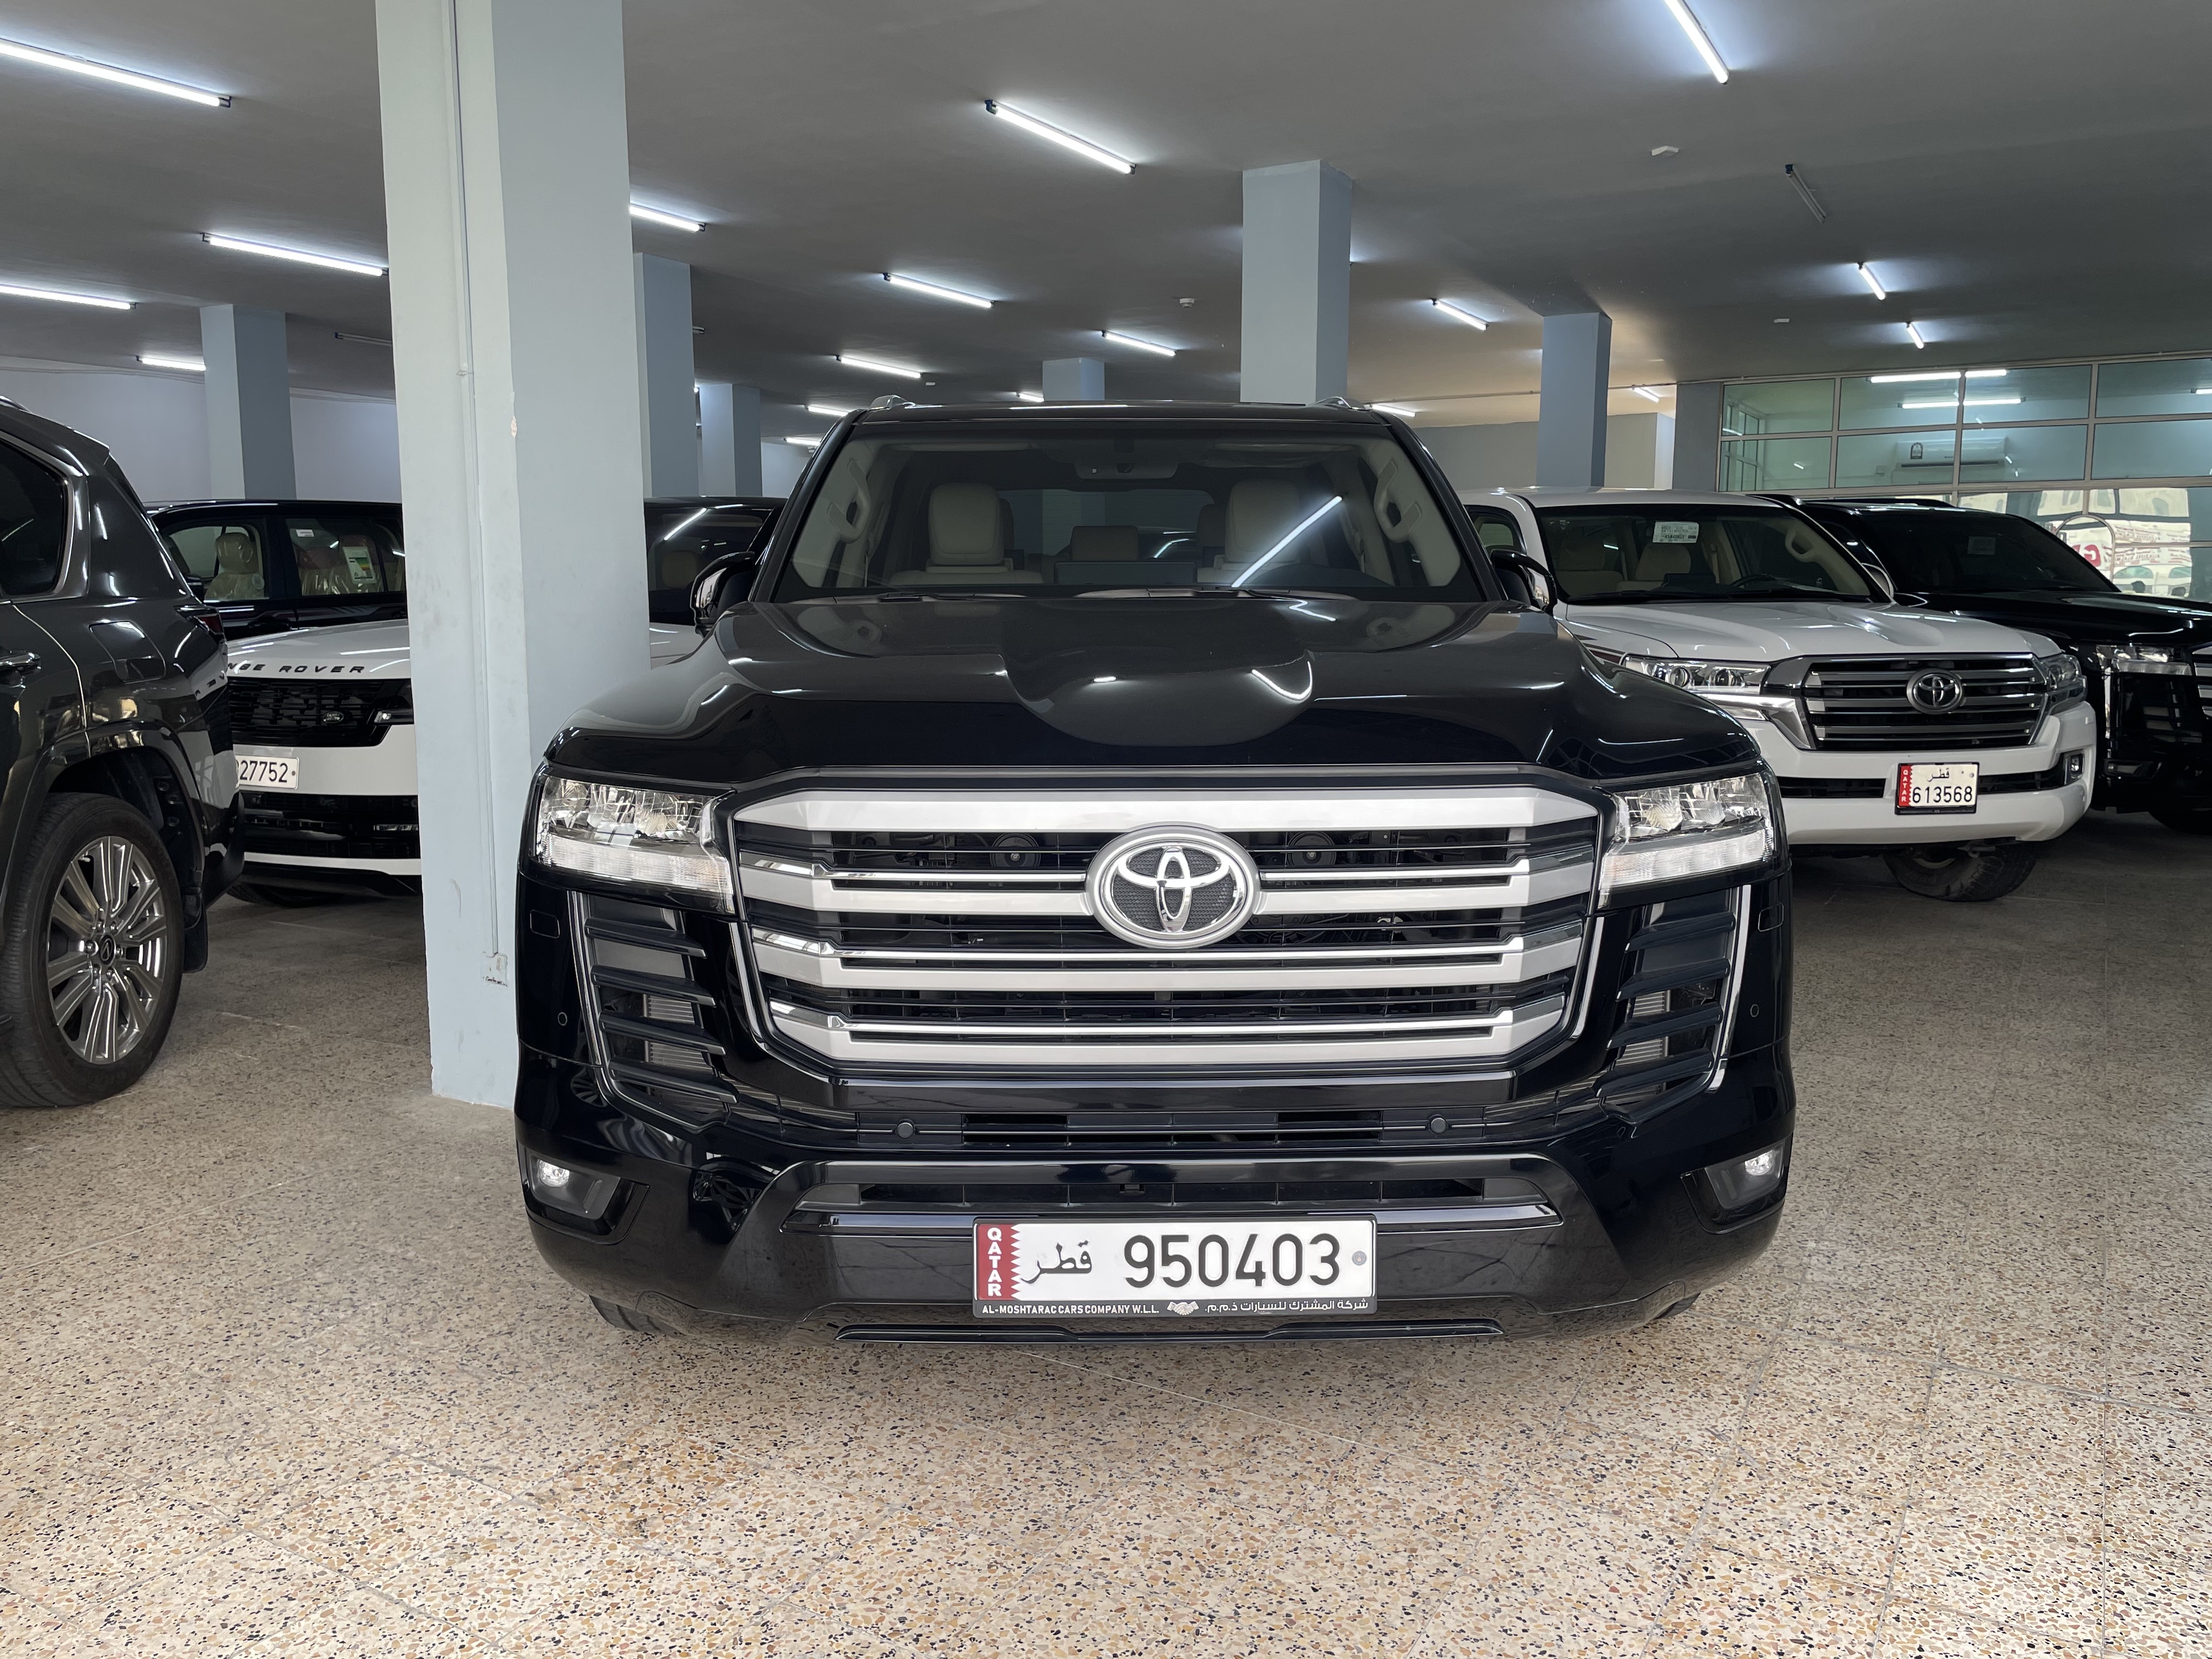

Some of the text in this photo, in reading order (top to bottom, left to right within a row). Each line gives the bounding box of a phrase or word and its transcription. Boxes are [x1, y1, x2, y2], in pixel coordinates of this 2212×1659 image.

[236, 760, 288, 783] 27752
[1926, 768, 1950, 782] قطر
[1912, 786, 1973, 803] 613568
[987, 1227, 1002, 1297] QATAR
[1020, 1239, 1092, 1284] قطر
[1124, 1233, 1340, 1288] 950403
[982, 1304, 1160, 1314] AL-MOSHTARAC CARS COMPANY W.L.L.
[1240, 1301, 1286, 1312] للسيارات
[1289, 1299, 1335, 1311] المشترك
[1337, 1298, 1368, 1310] شركة
